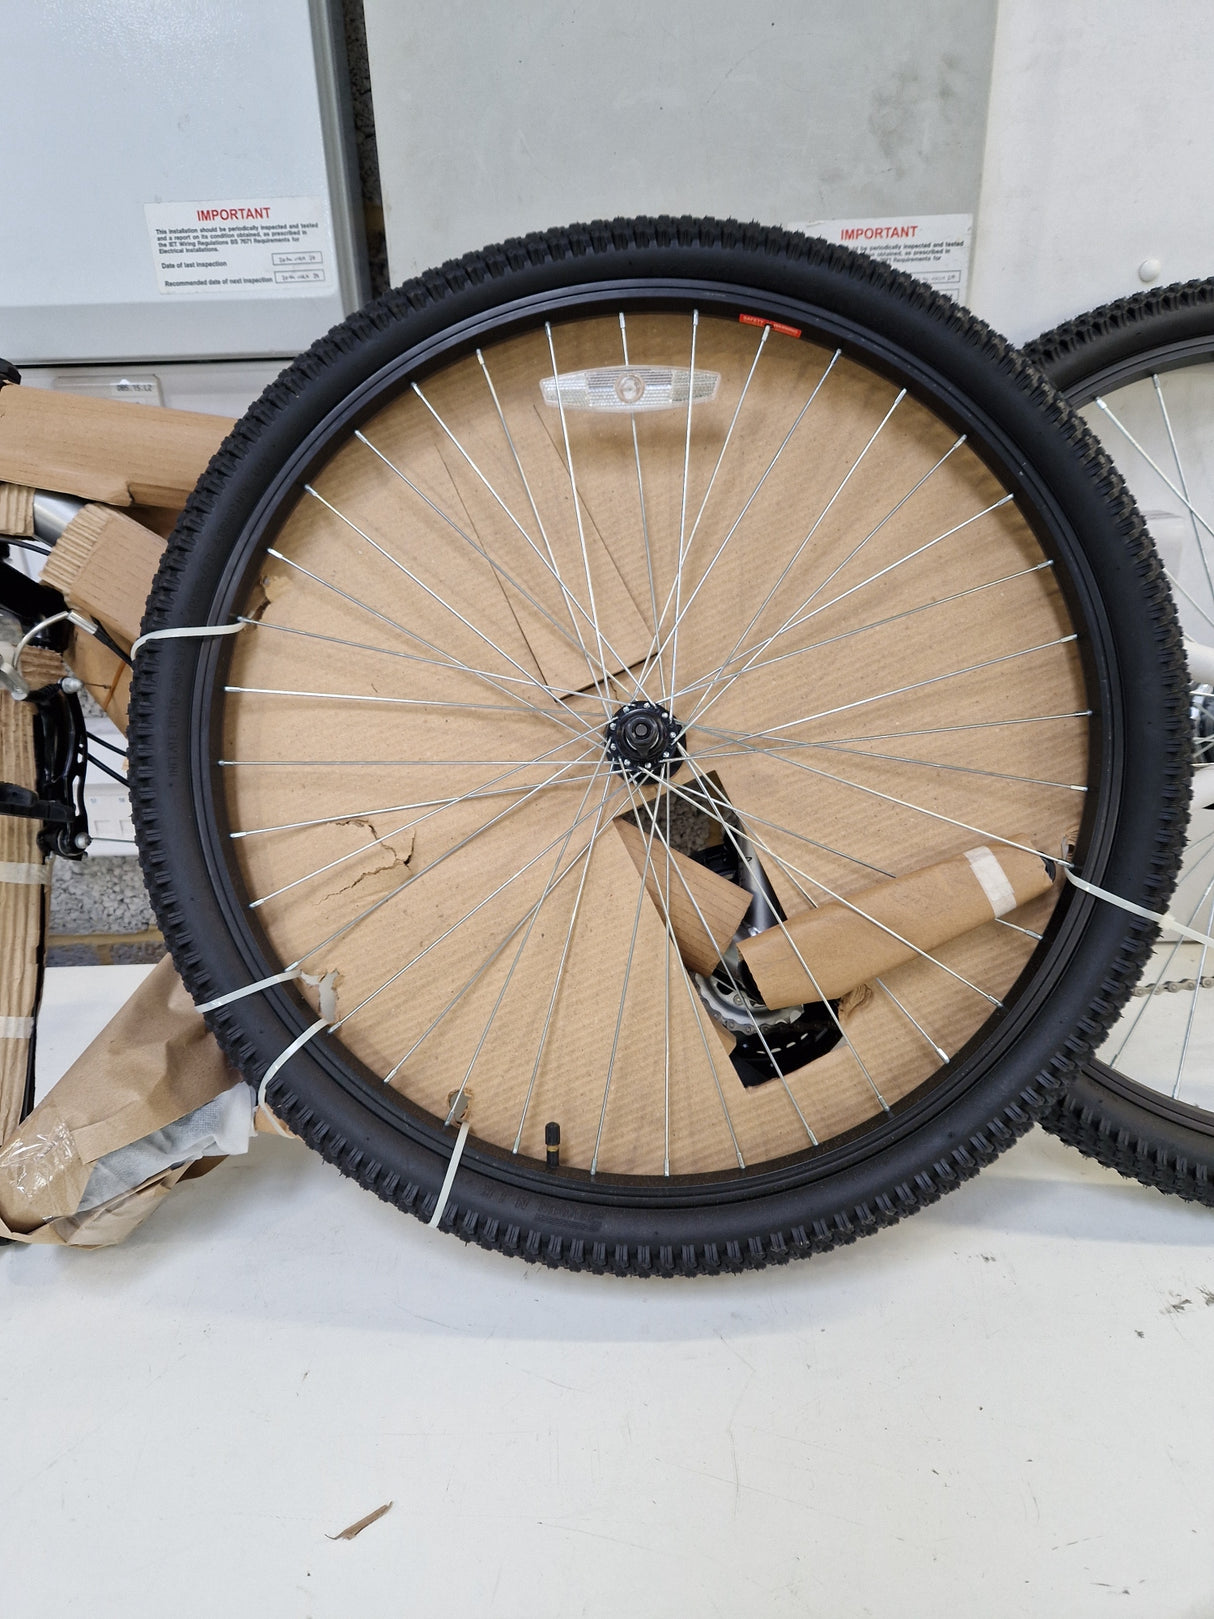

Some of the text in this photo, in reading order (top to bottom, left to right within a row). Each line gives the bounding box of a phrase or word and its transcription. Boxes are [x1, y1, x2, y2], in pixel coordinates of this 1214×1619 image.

[196, 207, 270, 222] IMPORTANT
[228, 224, 259, 233] periodically
[840, 226, 918, 240] IMPORTANT
[870, 244, 902, 252] periodically
